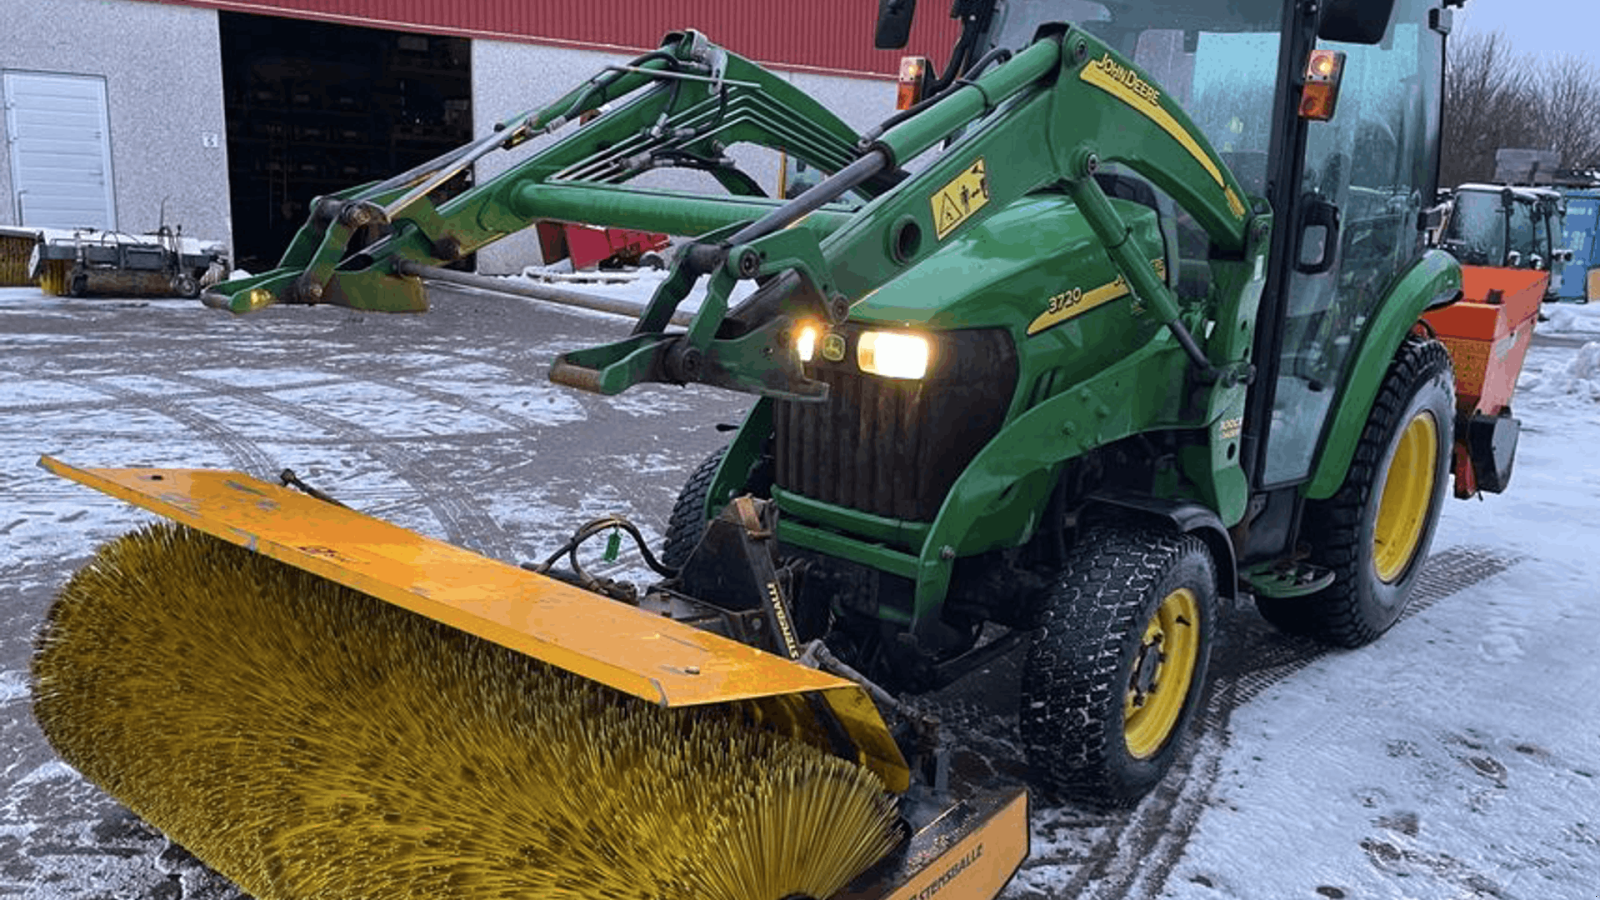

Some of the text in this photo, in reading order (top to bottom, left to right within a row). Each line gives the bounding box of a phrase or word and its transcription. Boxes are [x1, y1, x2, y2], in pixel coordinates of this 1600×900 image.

[1096, 53, 1160, 106] JOHN DEERE
[1049, 287, 1082, 314] 3720
